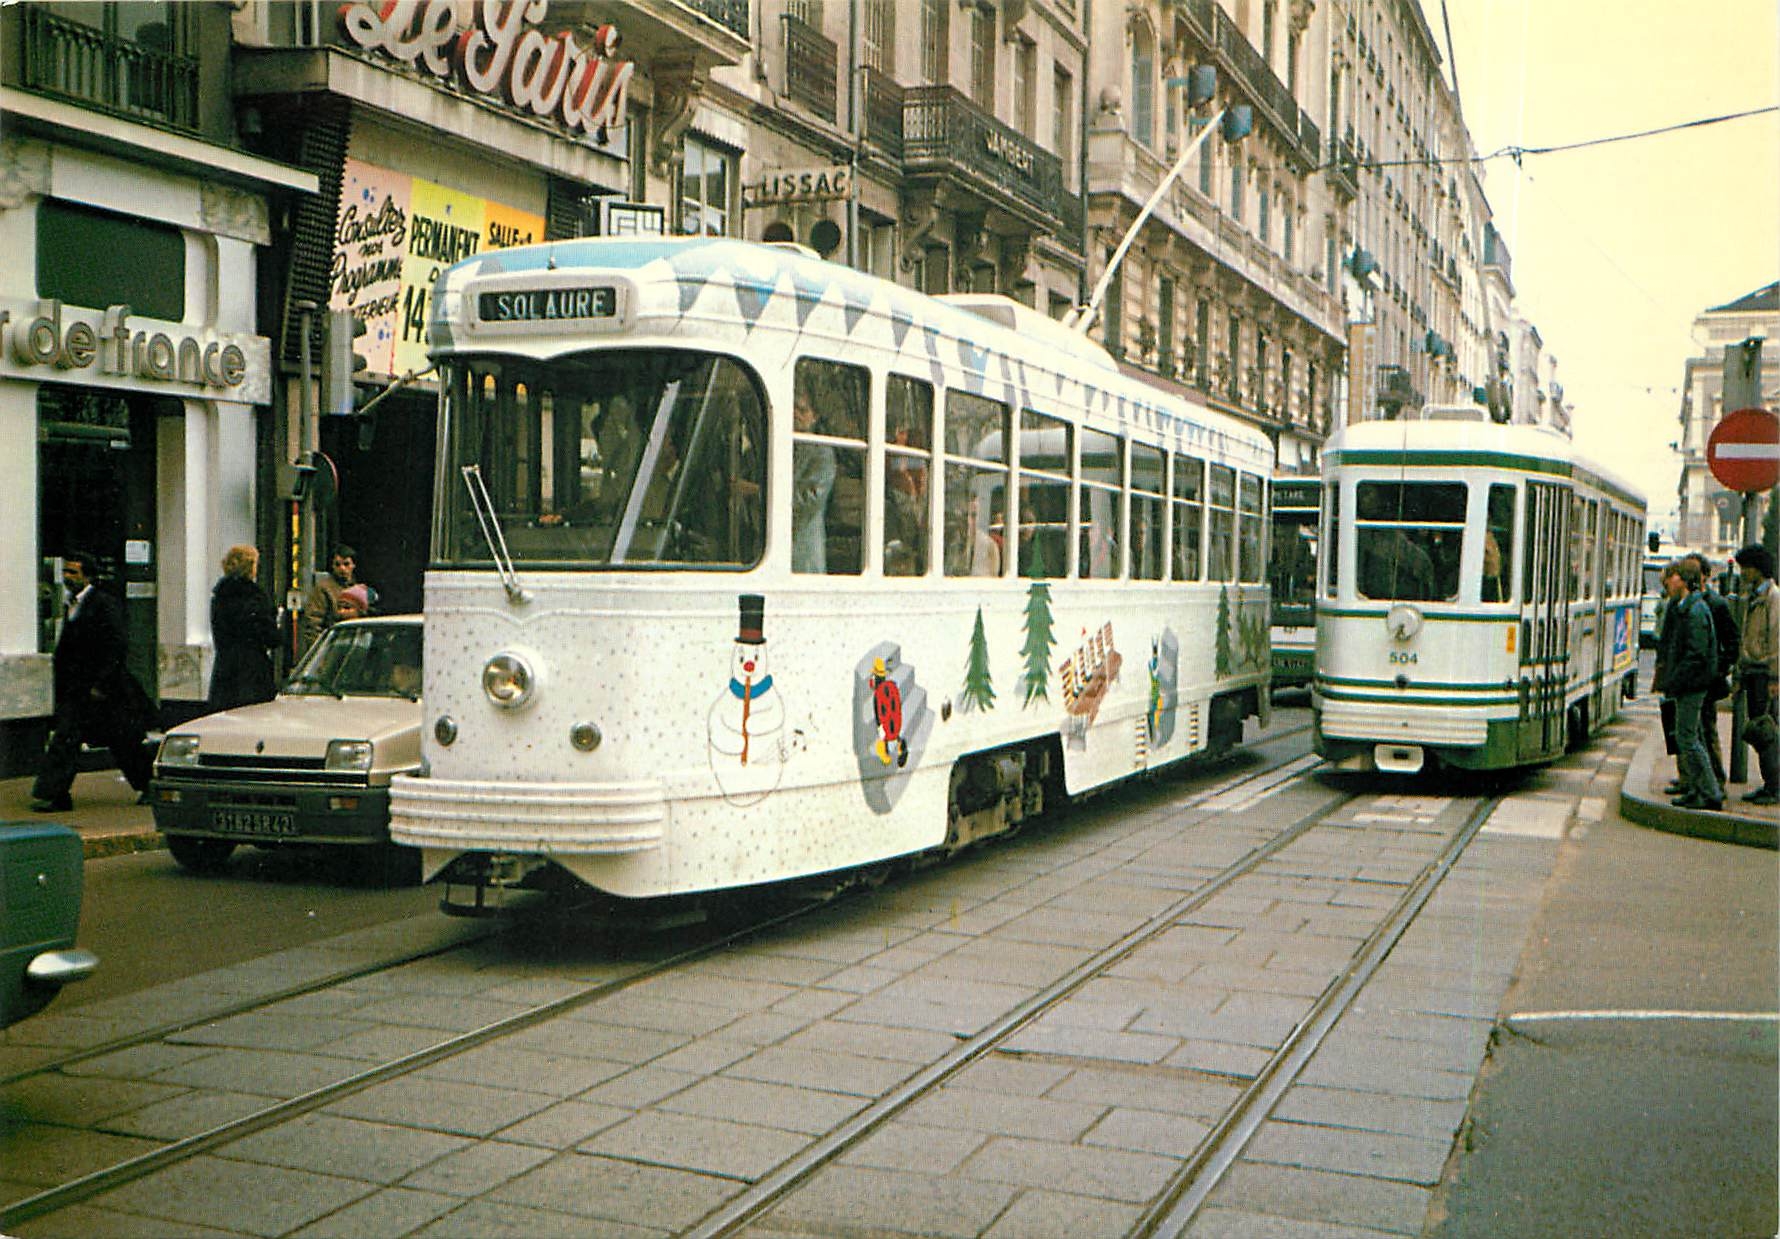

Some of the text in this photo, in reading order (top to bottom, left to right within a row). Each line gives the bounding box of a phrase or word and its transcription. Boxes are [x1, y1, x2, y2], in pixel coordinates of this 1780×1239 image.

[459, 0, 634, 138] Paris
[761, 171, 846, 196] LISSAC
[408, 213, 481, 264] PERMANENT
[488, 221, 519, 248] SALLE
[402, 284, 431, 345] 14
[497, 290, 607, 321] SOLAURE
[29, 299, 97, 370] de
[109, 304, 246, 387] france
[1389, 650, 1418, 665] 504
